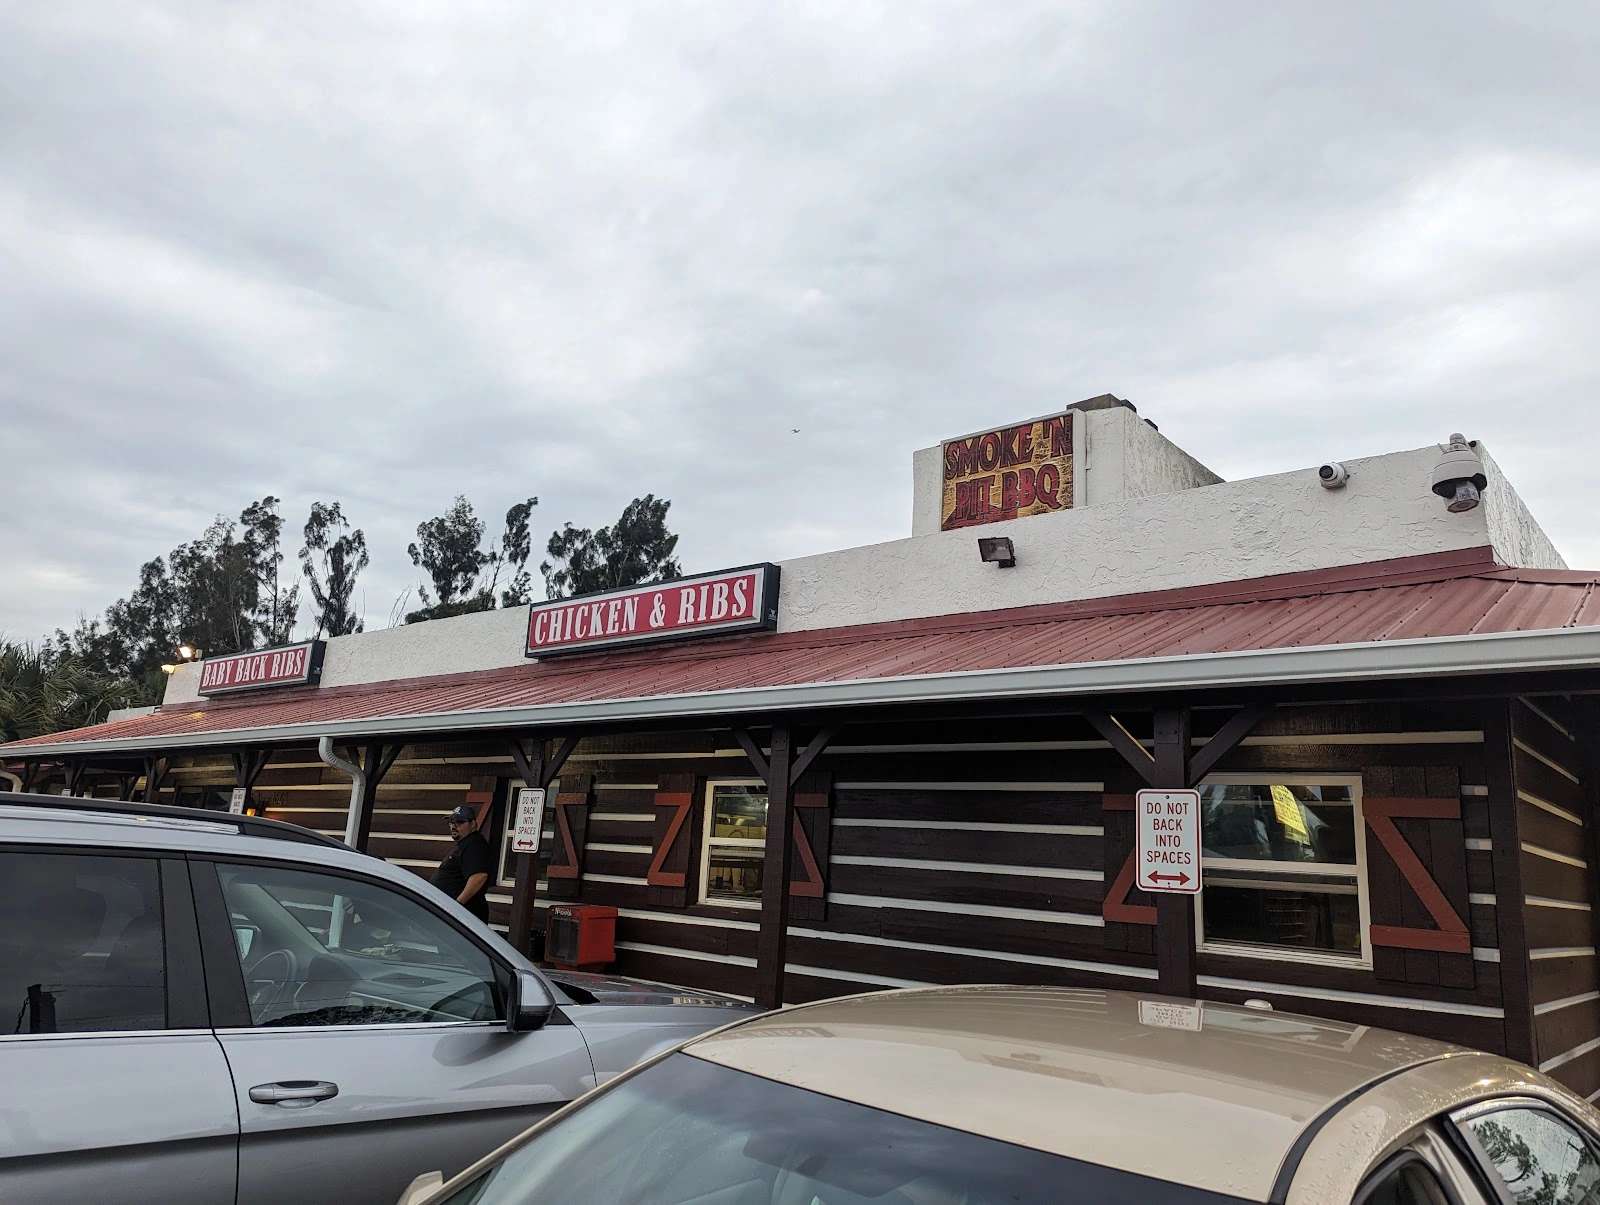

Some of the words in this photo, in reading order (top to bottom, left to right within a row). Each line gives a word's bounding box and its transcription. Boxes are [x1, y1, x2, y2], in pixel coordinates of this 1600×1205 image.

[945, 422, 1034, 480] SMOKE
[955, 474, 996, 519] PIT
[1001, 463, 1063, 511] BBQ
[534, 597, 640, 645] CHICKEN
[649, 592, 666, 628] &
[677, 578, 748, 624] RIBS
[202, 660, 234, 687] BABY
[235, 655, 268, 682] BACK
[270, 649, 304, 678] RIBS
[522, 796, 529, 804] DO
[530, 796, 540, 804] NOT
[523, 806, 536, 815] BACK
[1146, 802, 1162, 815] DO
[1167, 802, 1189, 815] NOT
[523, 816, 533, 825] INTO
[1153, 818, 1183, 831] BACK
[517, 826, 537, 835] SPACES
[1155, 834, 1181, 848] INTO
[1146, 850, 1191, 865] SPACES
